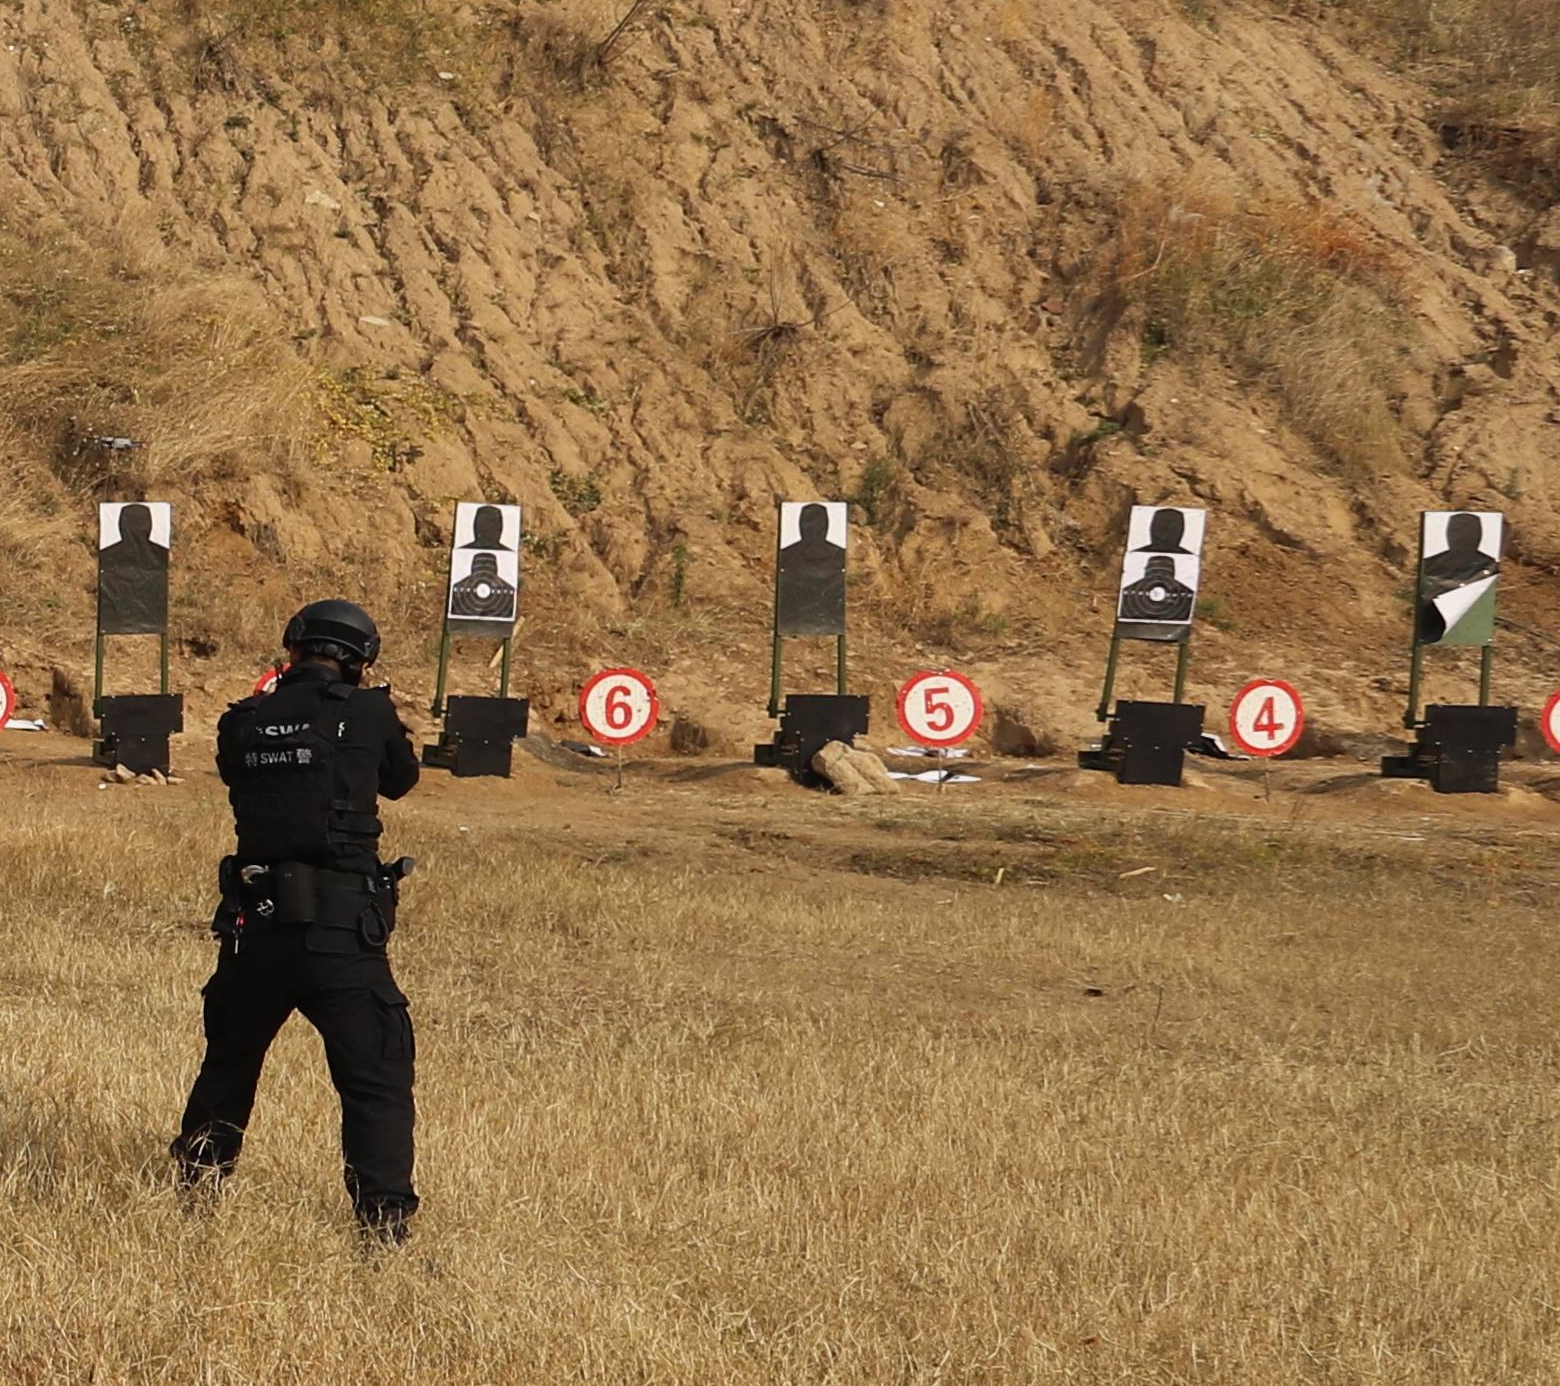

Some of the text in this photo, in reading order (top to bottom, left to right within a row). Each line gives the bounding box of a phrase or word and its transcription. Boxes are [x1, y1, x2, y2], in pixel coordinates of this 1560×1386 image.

[605, 684, 634, 731] 6
[924, 685, 956, 732] 5
[1252, 695, 1284, 741] 4
[260, 751, 294, 764] SWAT
